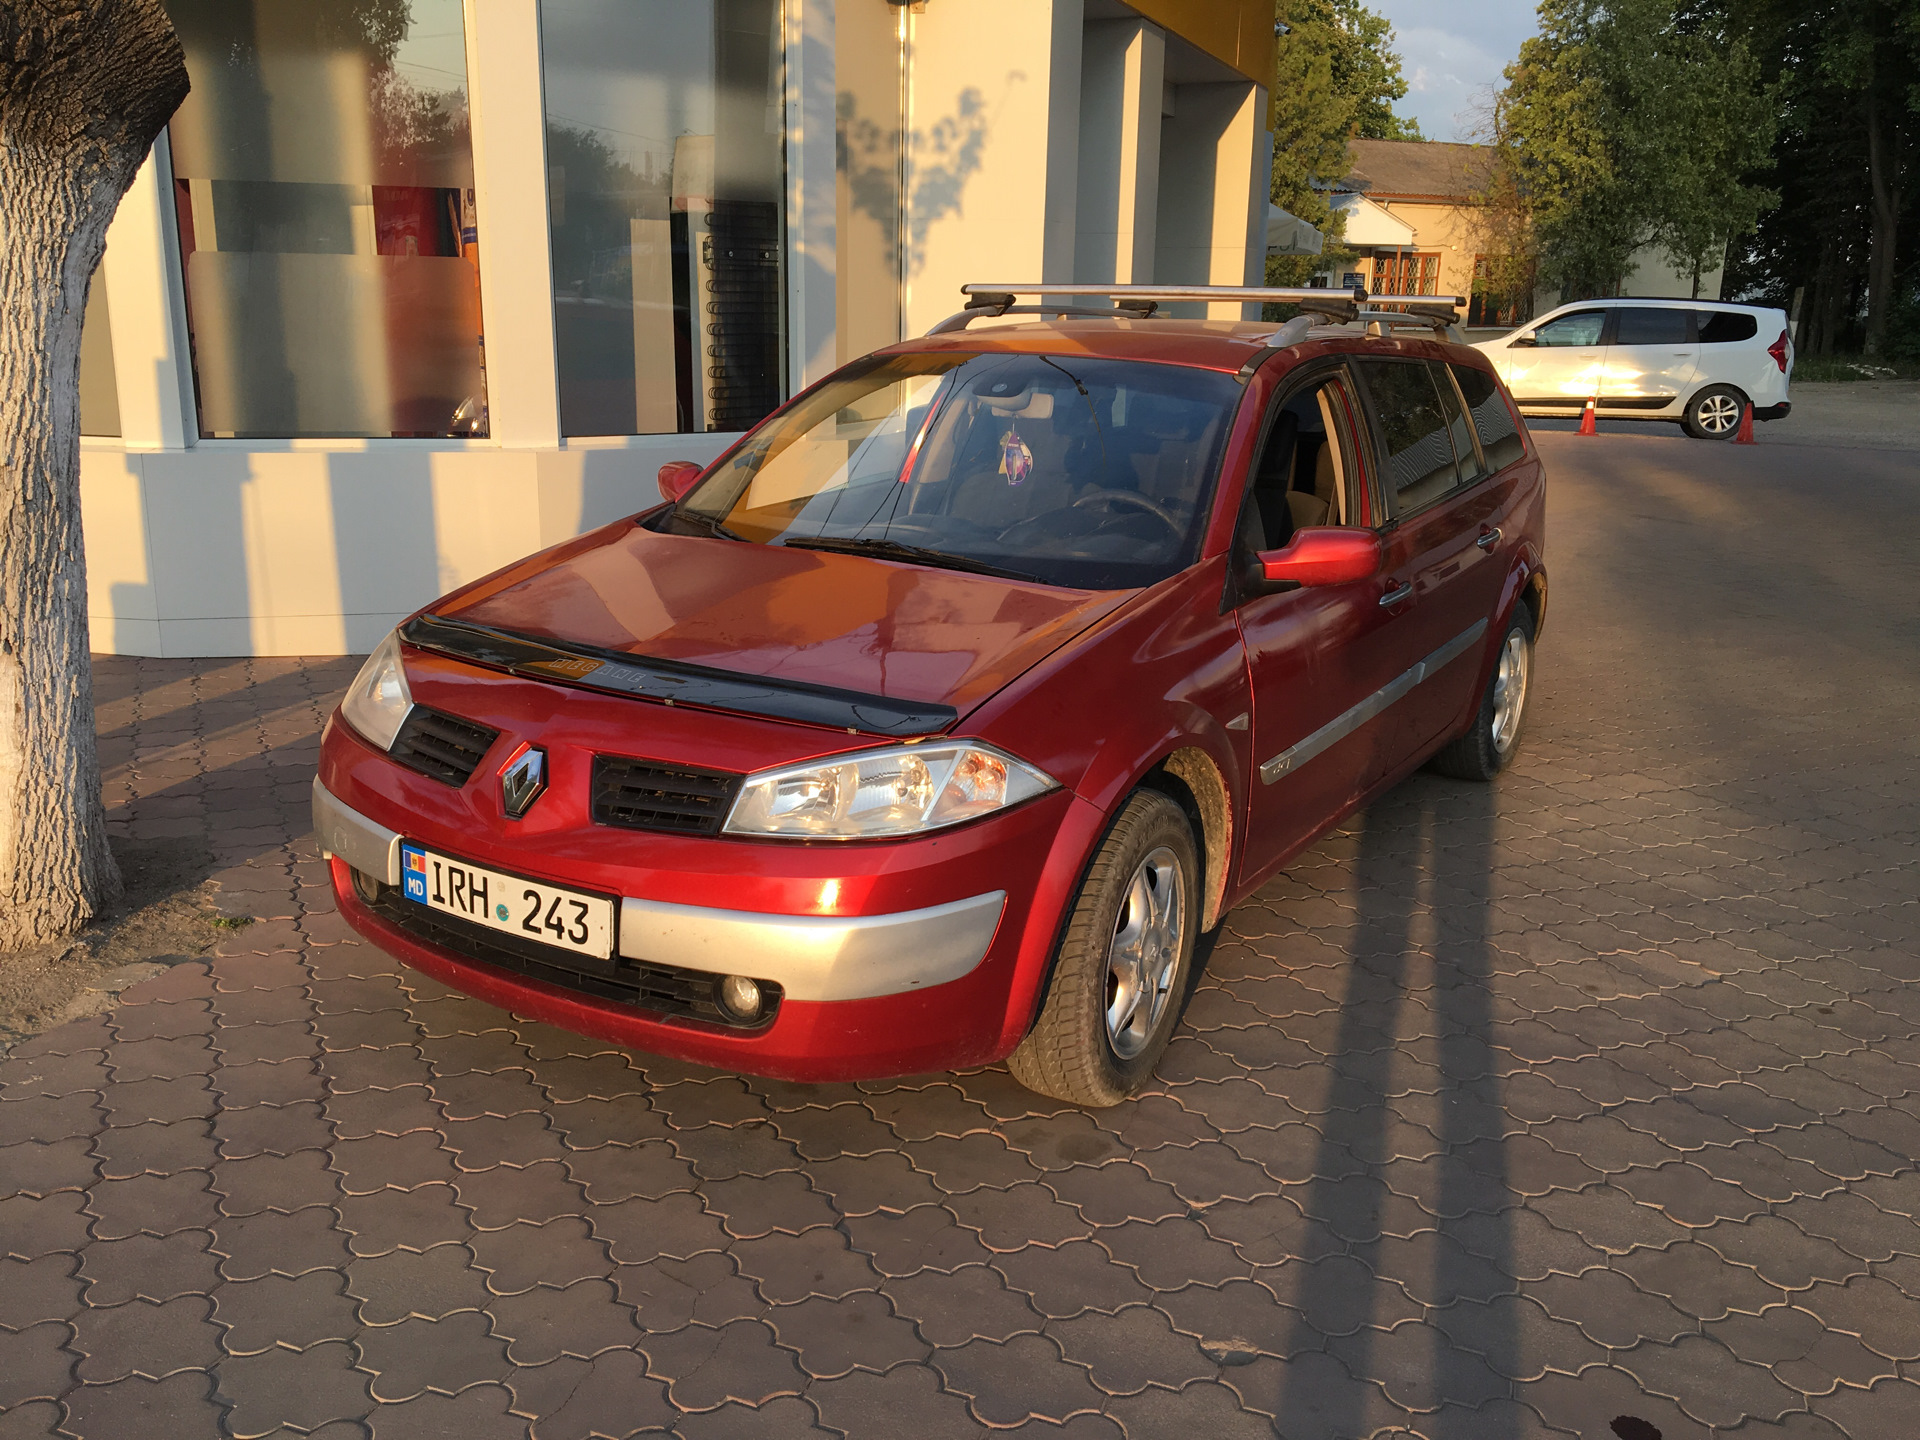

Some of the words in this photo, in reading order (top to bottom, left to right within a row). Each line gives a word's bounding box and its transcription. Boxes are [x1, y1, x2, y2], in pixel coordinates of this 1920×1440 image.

[548, 658, 646, 683] MEGANE
[407, 876, 424, 897] MD
[432, 860, 489, 919] IRH
[522, 889, 589, 945] 243
